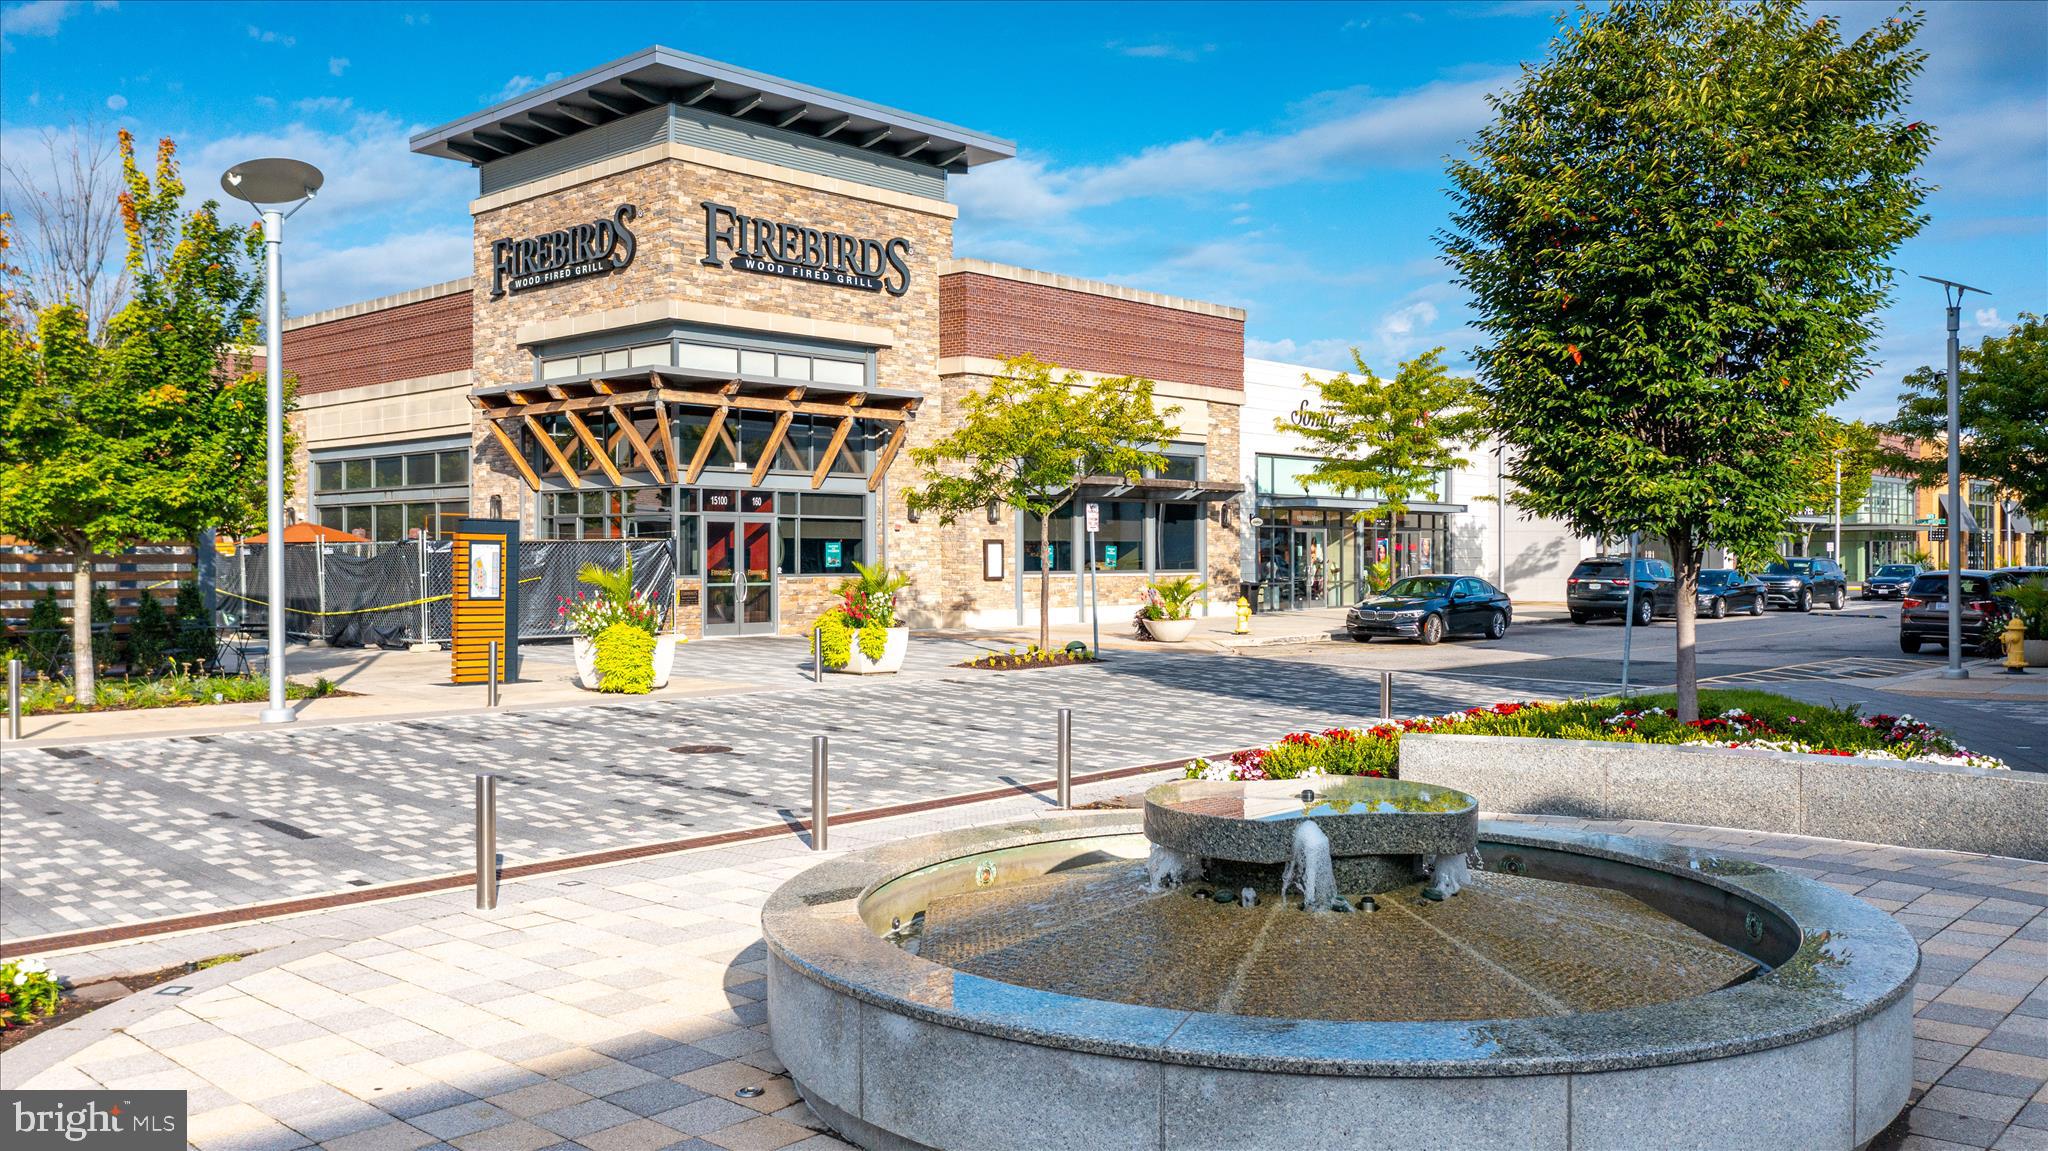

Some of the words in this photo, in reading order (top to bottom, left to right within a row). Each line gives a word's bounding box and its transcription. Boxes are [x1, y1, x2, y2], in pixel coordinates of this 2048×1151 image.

[490, 203, 637, 296] FIREBIRDS
[700, 201, 911, 297] FIREBIRDS
[514, 275, 541, 288] WOOD
[544, 268, 571, 282] FIRED
[575, 262, 604, 275] GRILL
[745, 259, 784, 274] WOOD
[792, 267, 830, 281] FIRED
[837, 274, 873, 288] GRILL
[710, 495, 728, 505] 15100
[752, 497, 762, 506] 160
